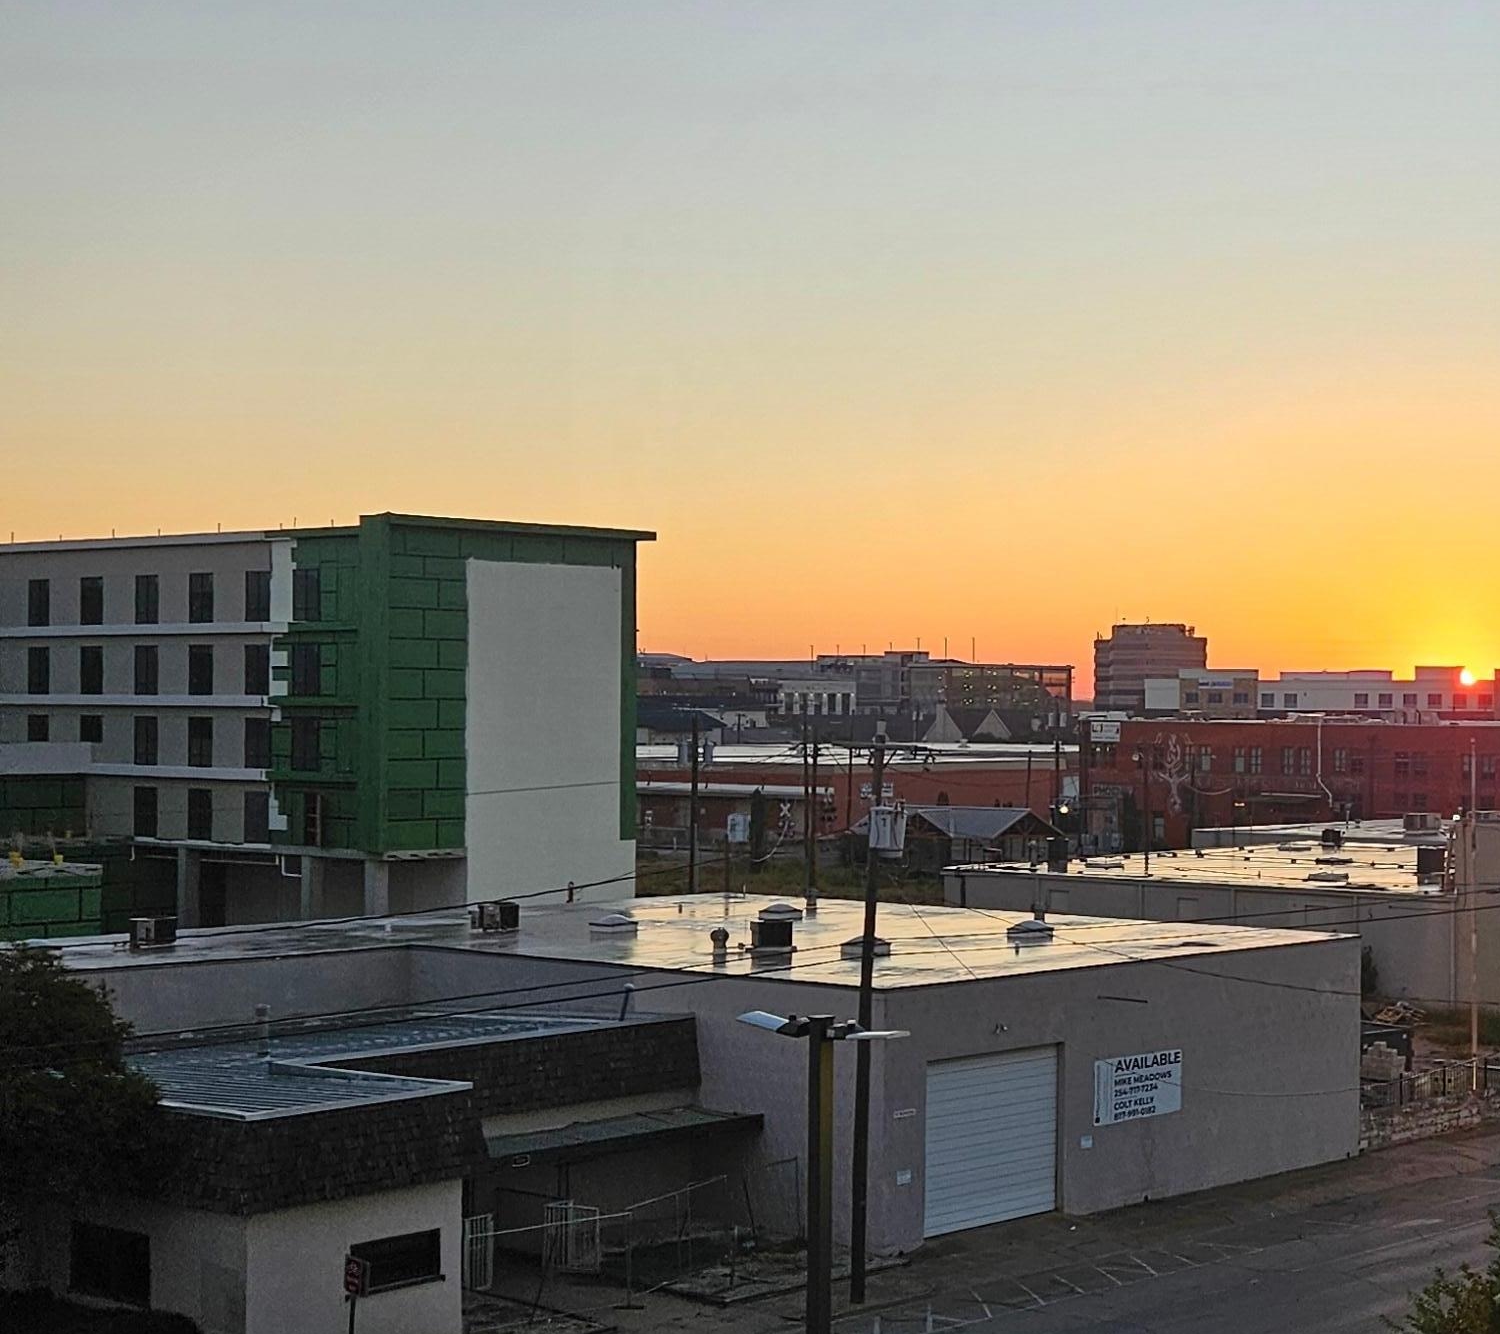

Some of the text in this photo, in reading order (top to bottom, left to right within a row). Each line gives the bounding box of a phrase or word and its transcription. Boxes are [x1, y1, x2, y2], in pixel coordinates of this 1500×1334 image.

[1114, 1051, 1181, 1073] AVAILABLE
[1114, 1070, 1172, 1087] MIKE MEADOWS
[1114, 1096, 1155, 1111] COLT KELLY
